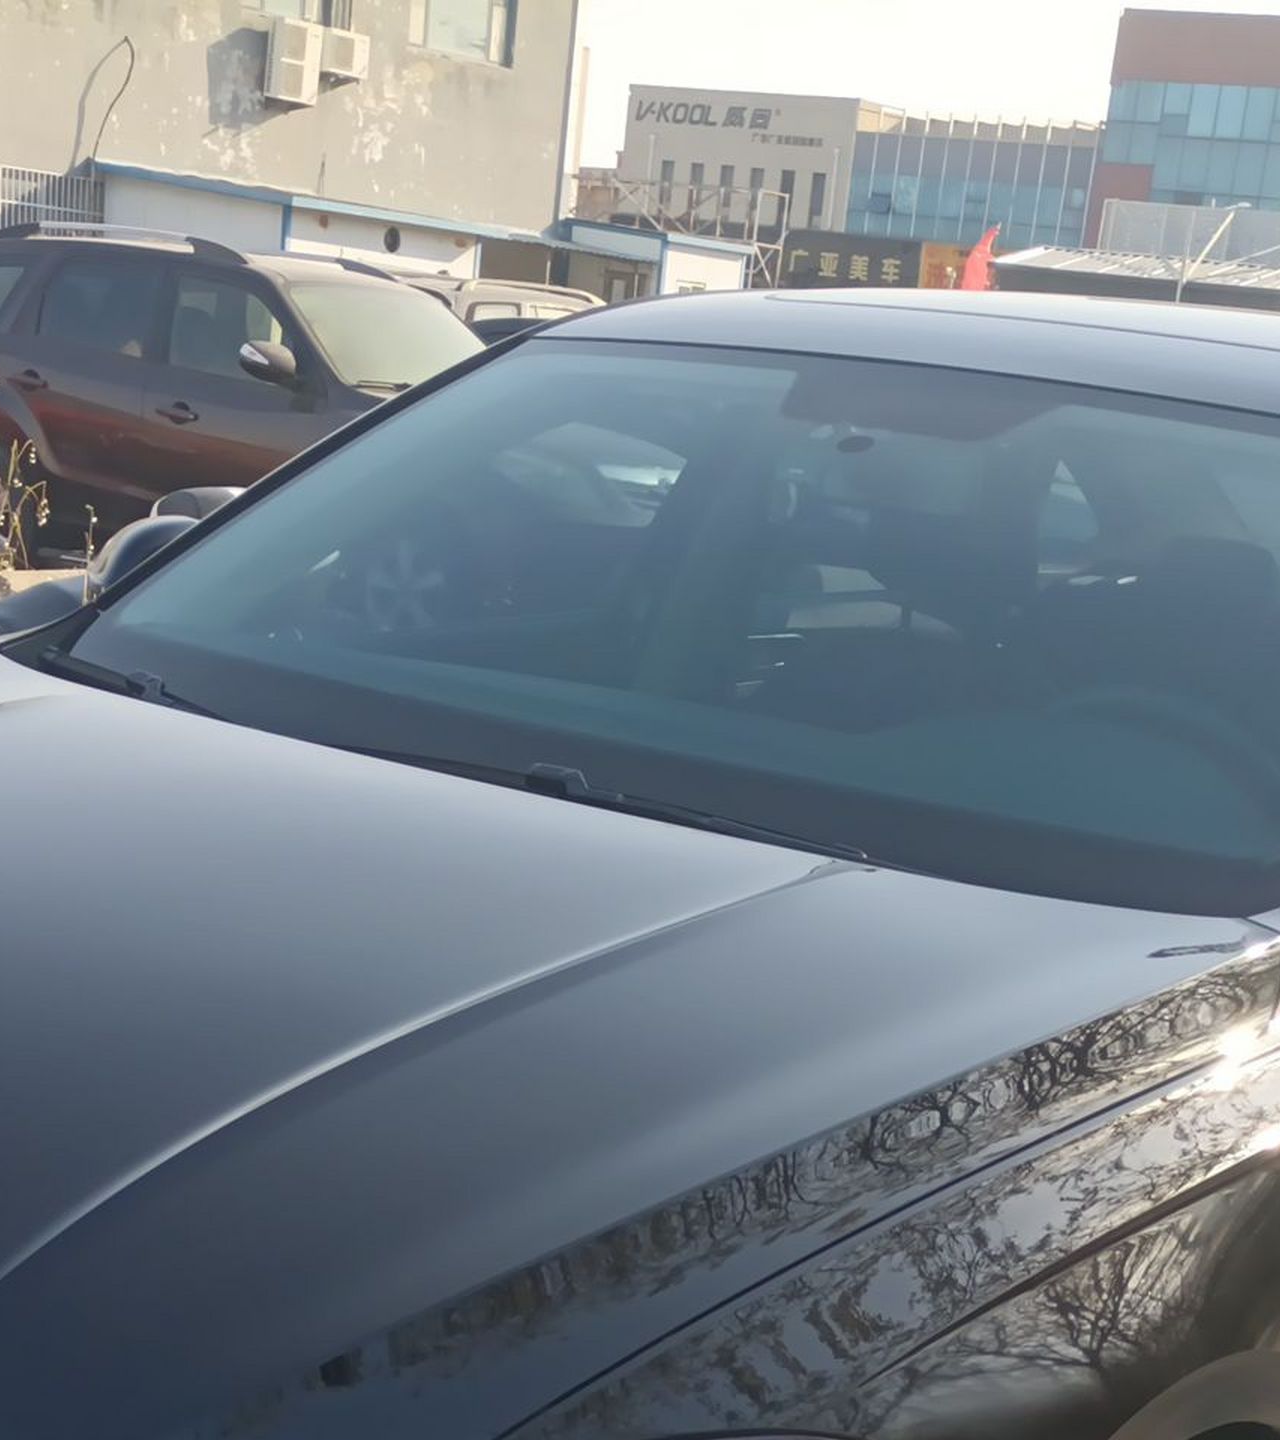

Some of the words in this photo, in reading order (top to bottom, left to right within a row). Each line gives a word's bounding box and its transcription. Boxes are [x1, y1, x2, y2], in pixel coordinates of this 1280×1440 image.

[635, 100, 718, 128] V-KOOL
[788, 249, 902, 284] 广亚美车
